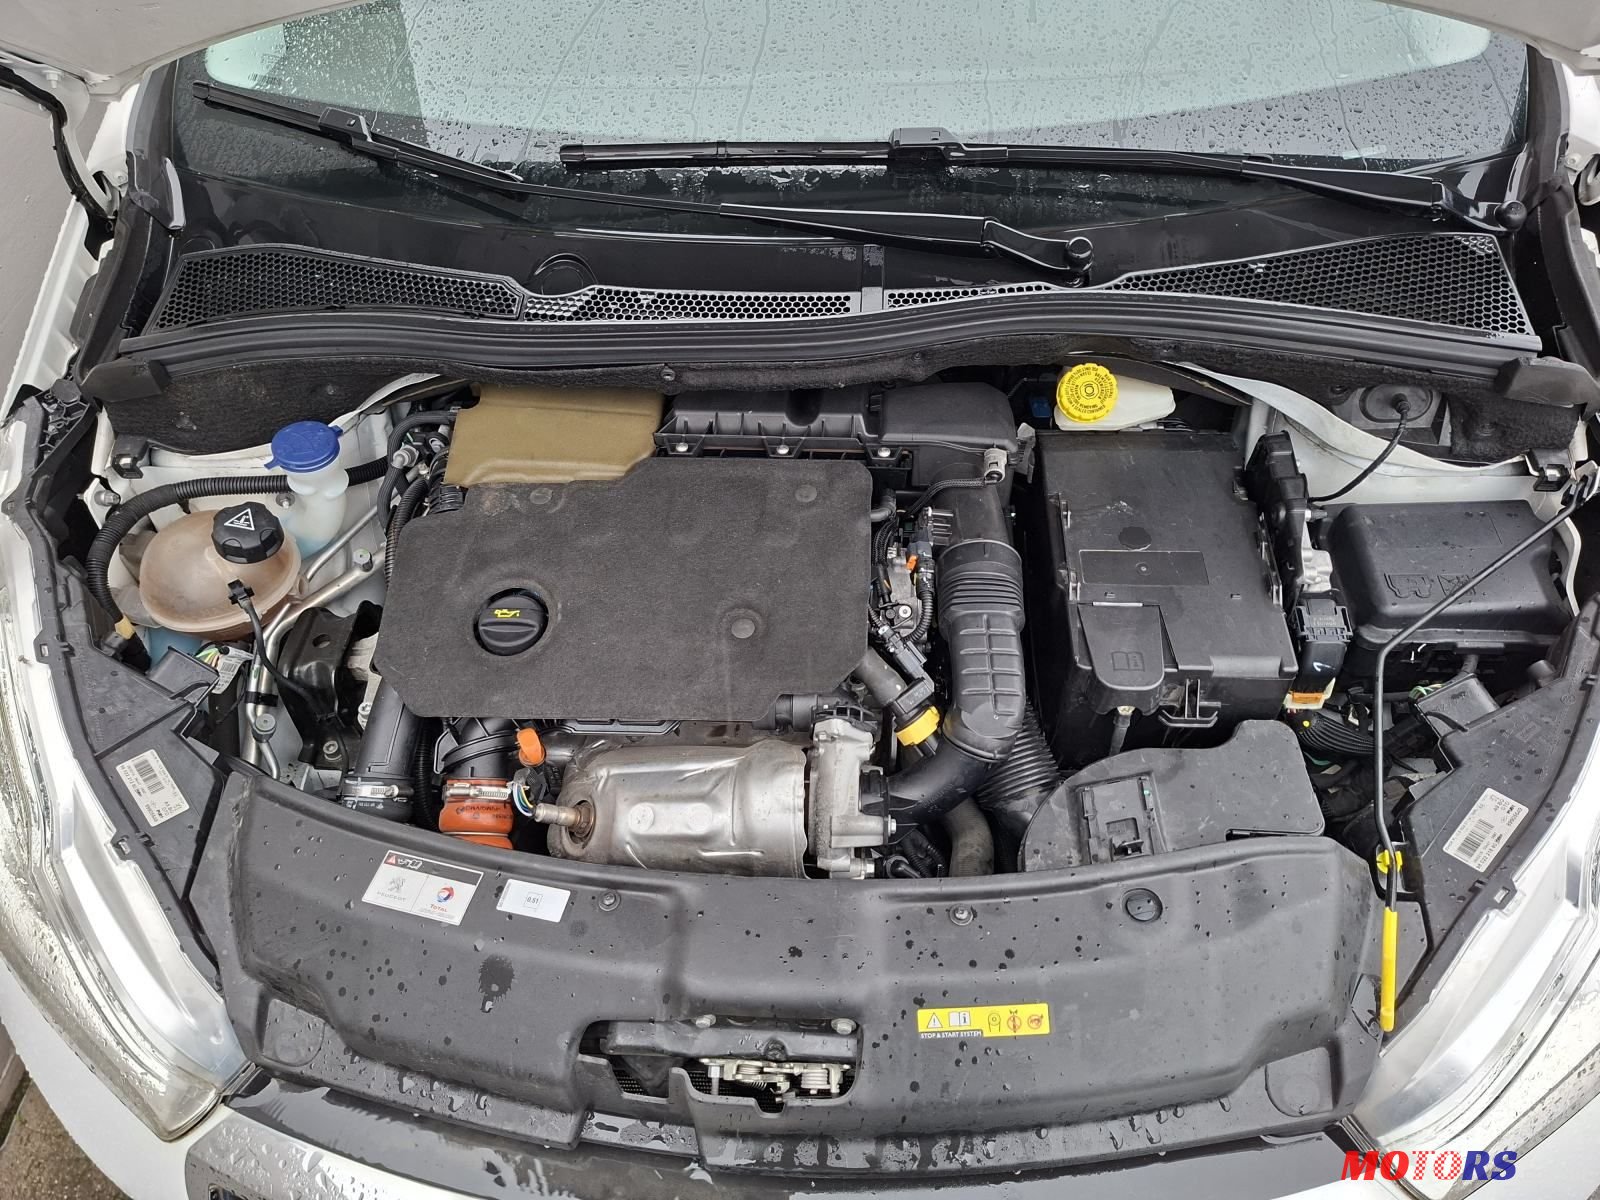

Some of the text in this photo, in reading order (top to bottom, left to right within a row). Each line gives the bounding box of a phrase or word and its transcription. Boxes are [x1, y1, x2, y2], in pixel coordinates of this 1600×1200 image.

[430, 903, 448, 913] TOTAL
[920, 1031, 936, 1039] STOP
[960, 1030, 982, 1038] SYSTEM
